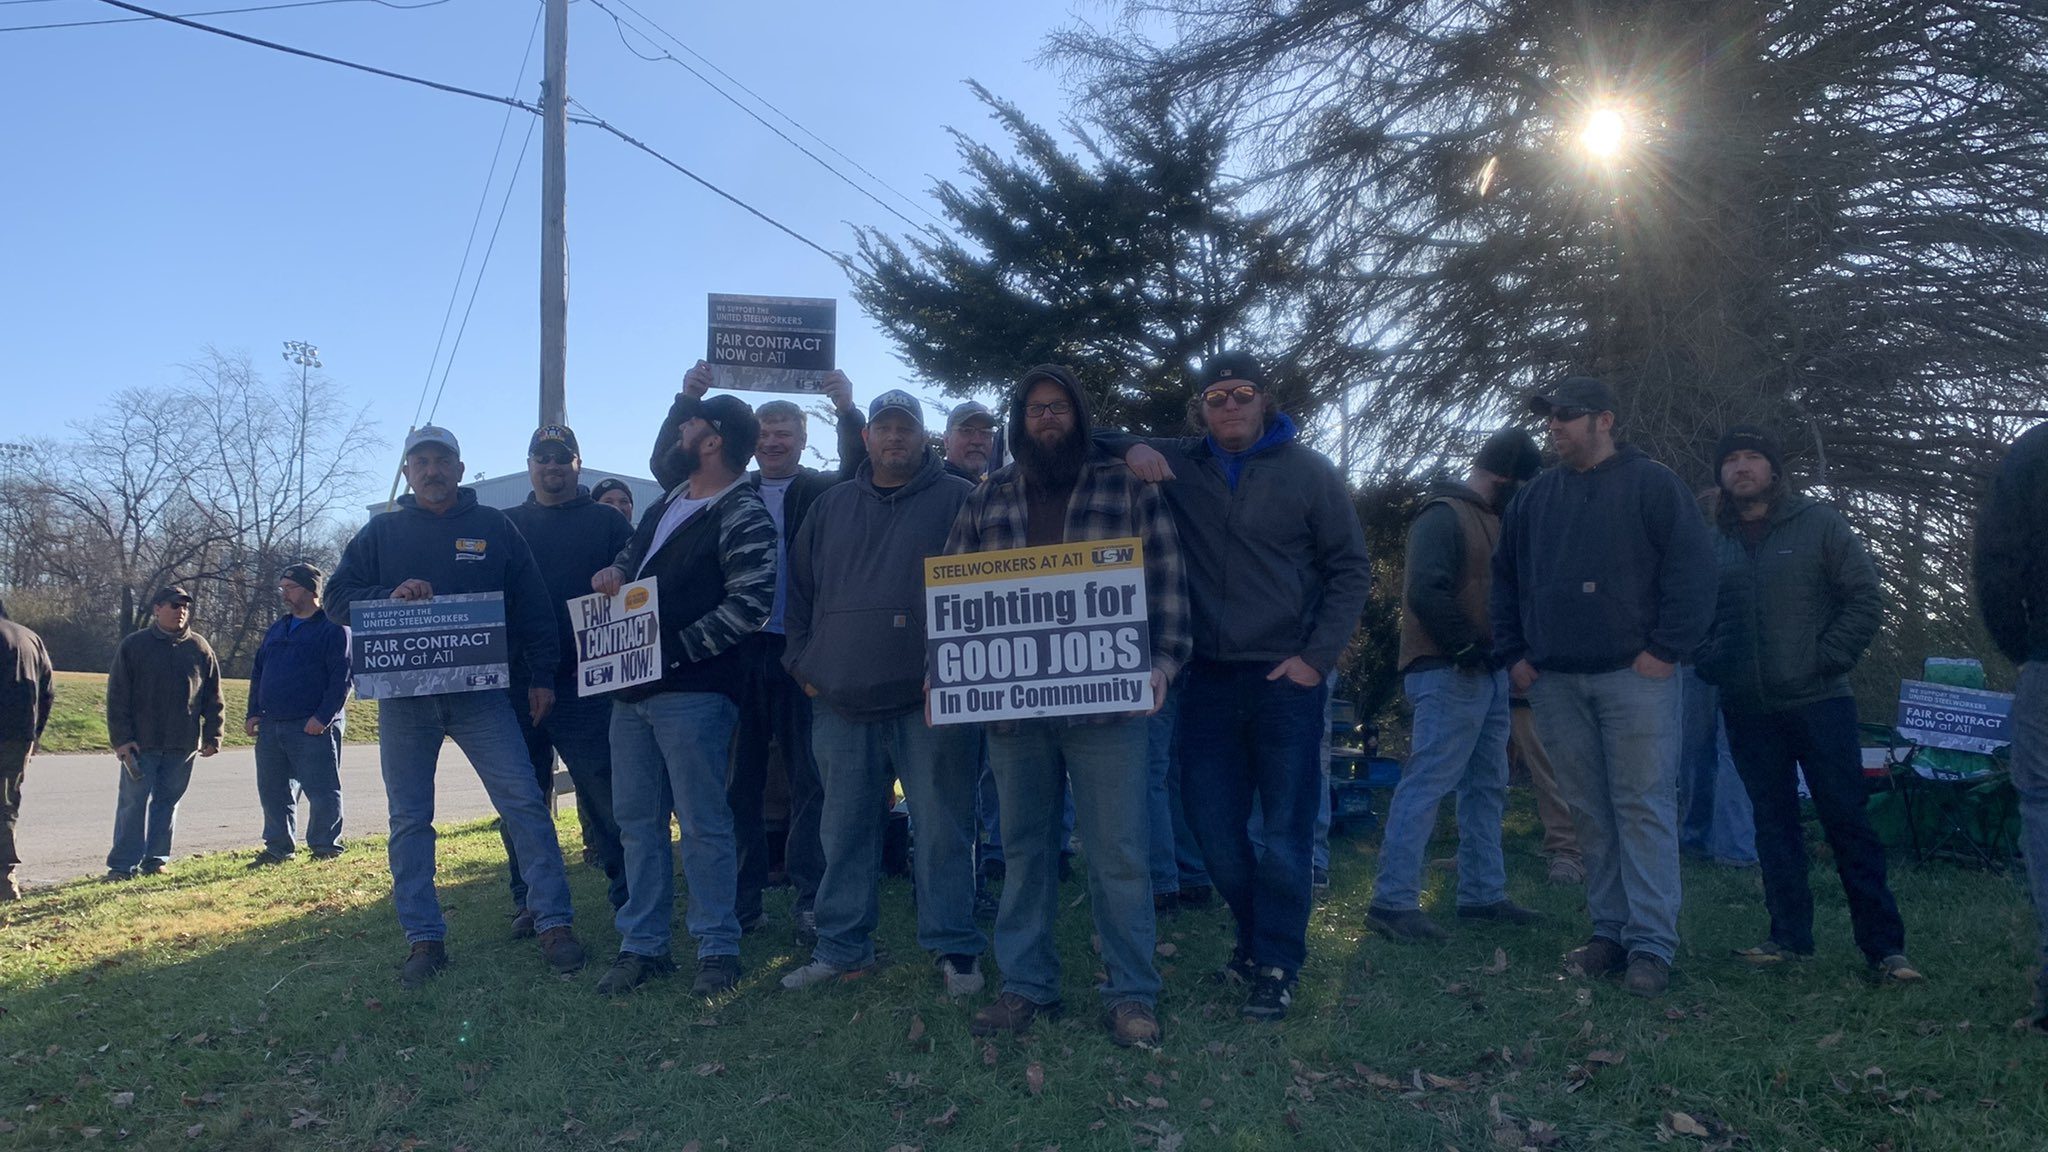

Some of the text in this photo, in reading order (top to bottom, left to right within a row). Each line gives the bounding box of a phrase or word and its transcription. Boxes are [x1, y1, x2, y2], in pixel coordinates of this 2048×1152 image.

[727, 306, 756, 314] SUPPORT
[716, 313, 802, 325] UNITED STEELWORKERS
[716, 333, 821, 350] FAIR CONTRACT
[716, 348, 785, 363] NOW at ATI
[1092, 548, 1134, 564] USW
[932, 552, 1082, 580] STEELWORKERS AT ATI
[378, 609, 415, 618] SUPPORT
[417, 608, 432, 616] THE
[581, 595, 611, 628] FAIR
[934, 582, 1136, 634] Fighting for
[363, 614, 469, 628] UNITED STEELWORKERS
[364, 632, 491, 653] FAIR CONTRACT
[586, 613, 651, 659] CONTRACT
[365, 650, 453, 668] NOW at ATI
[937, 627, 1142, 684] GOOD JOBS
[621, 648, 654, 683] NOW!
[466, 674, 499, 687] USW
[585, 666, 613, 687] USW
[940, 678, 1143, 715] In Our Community
[1908, 694, 1987, 710] UNITED STEELWORKERS
[1920, 689, 1947, 698] SUPPORT
[1906, 707, 2002, 728] FAIR CONTRACT
[1906, 717, 1972, 734] NOW at ATI
